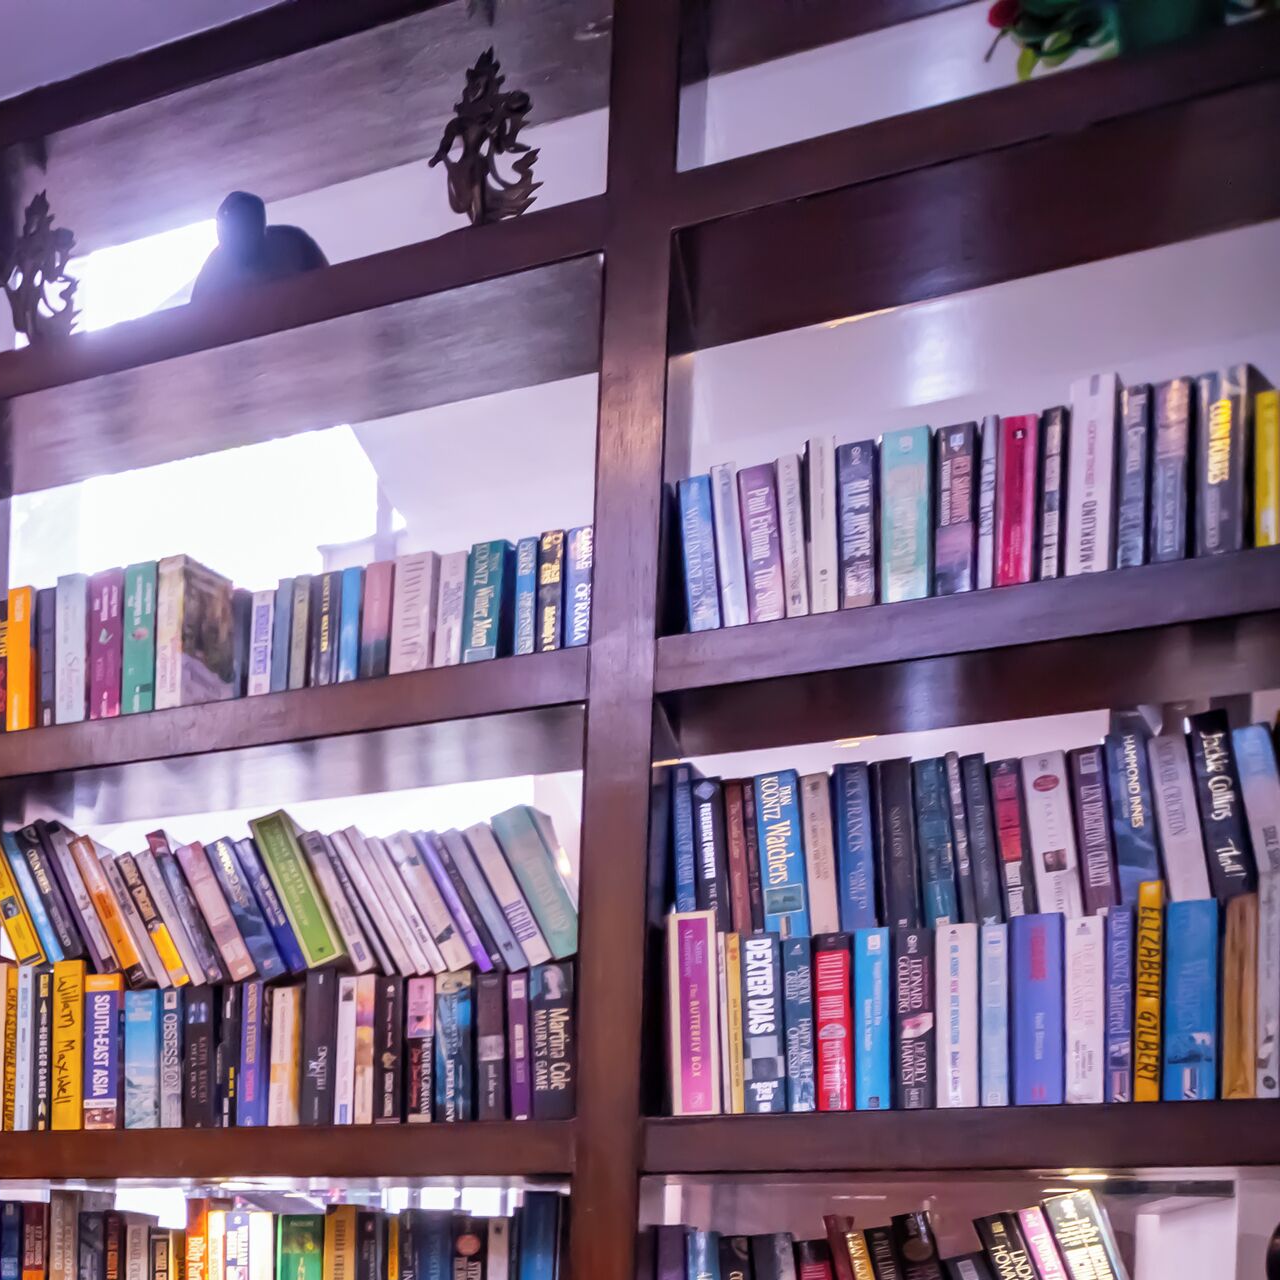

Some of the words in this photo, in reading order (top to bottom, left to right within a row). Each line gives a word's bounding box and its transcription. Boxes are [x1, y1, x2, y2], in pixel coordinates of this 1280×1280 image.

[1123, 735, 1141, 793] HAMMOND
[1200, 732, 1228, 772] Jackie
[760, 776, 781, 820] KOONTZ
[779, 785, 792, 807] DEAN
[1129, 796, 1144, 828] INNES
[1208, 776, 1234, 820] Collins
[699, 803, 713, 842] FREDERICK
[847, 801, 864, 852] FRANCIS
[1082, 802, 1106, 846] DEIGHTON
[765, 820, 795, 884] Watchers
[503, 900, 537, 942] DECIDER
[746, 938, 773, 997] DEXTER
[1139, 907, 1161, 998] ELIZABETH
[897, 956, 910, 1013] GOLDBERG
[909, 959, 923, 1008] LEONARD
[93, 995, 111, 1066] SOUTH-EAST
[690, 1000, 702, 1052] BUTTERFLY
[748, 998, 775, 1034] DIAS
[1109, 983, 1130, 1034] Shattered
[163, 1013, 178, 1090] OBSESSION
[534, 1010, 547, 1056] MAURA'S
[549, 1008, 570, 1058] Martina
[1137, 1011, 1159, 1082] GILBERT
[421, 1038, 432, 1076] HEATHER
[535, 1061, 548, 1091] GAME
[550, 1062, 571, 1091] Cole
[692, 1056, 702, 1077] BOX
[901, 1040, 914, 1087] HARVEST
[914, 1041, 927, 1082] DEADLY
[93, 1070, 109, 1096] ASIA
[420, 1077, 432, 1114] GRAHAM
[34, 1225, 42, 1239] 127
[34, 1241, 42, 1266] HOURS
[54, 1218, 63, 1271] CALLING
[130, 1228, 142, 1261] MICHAEL
